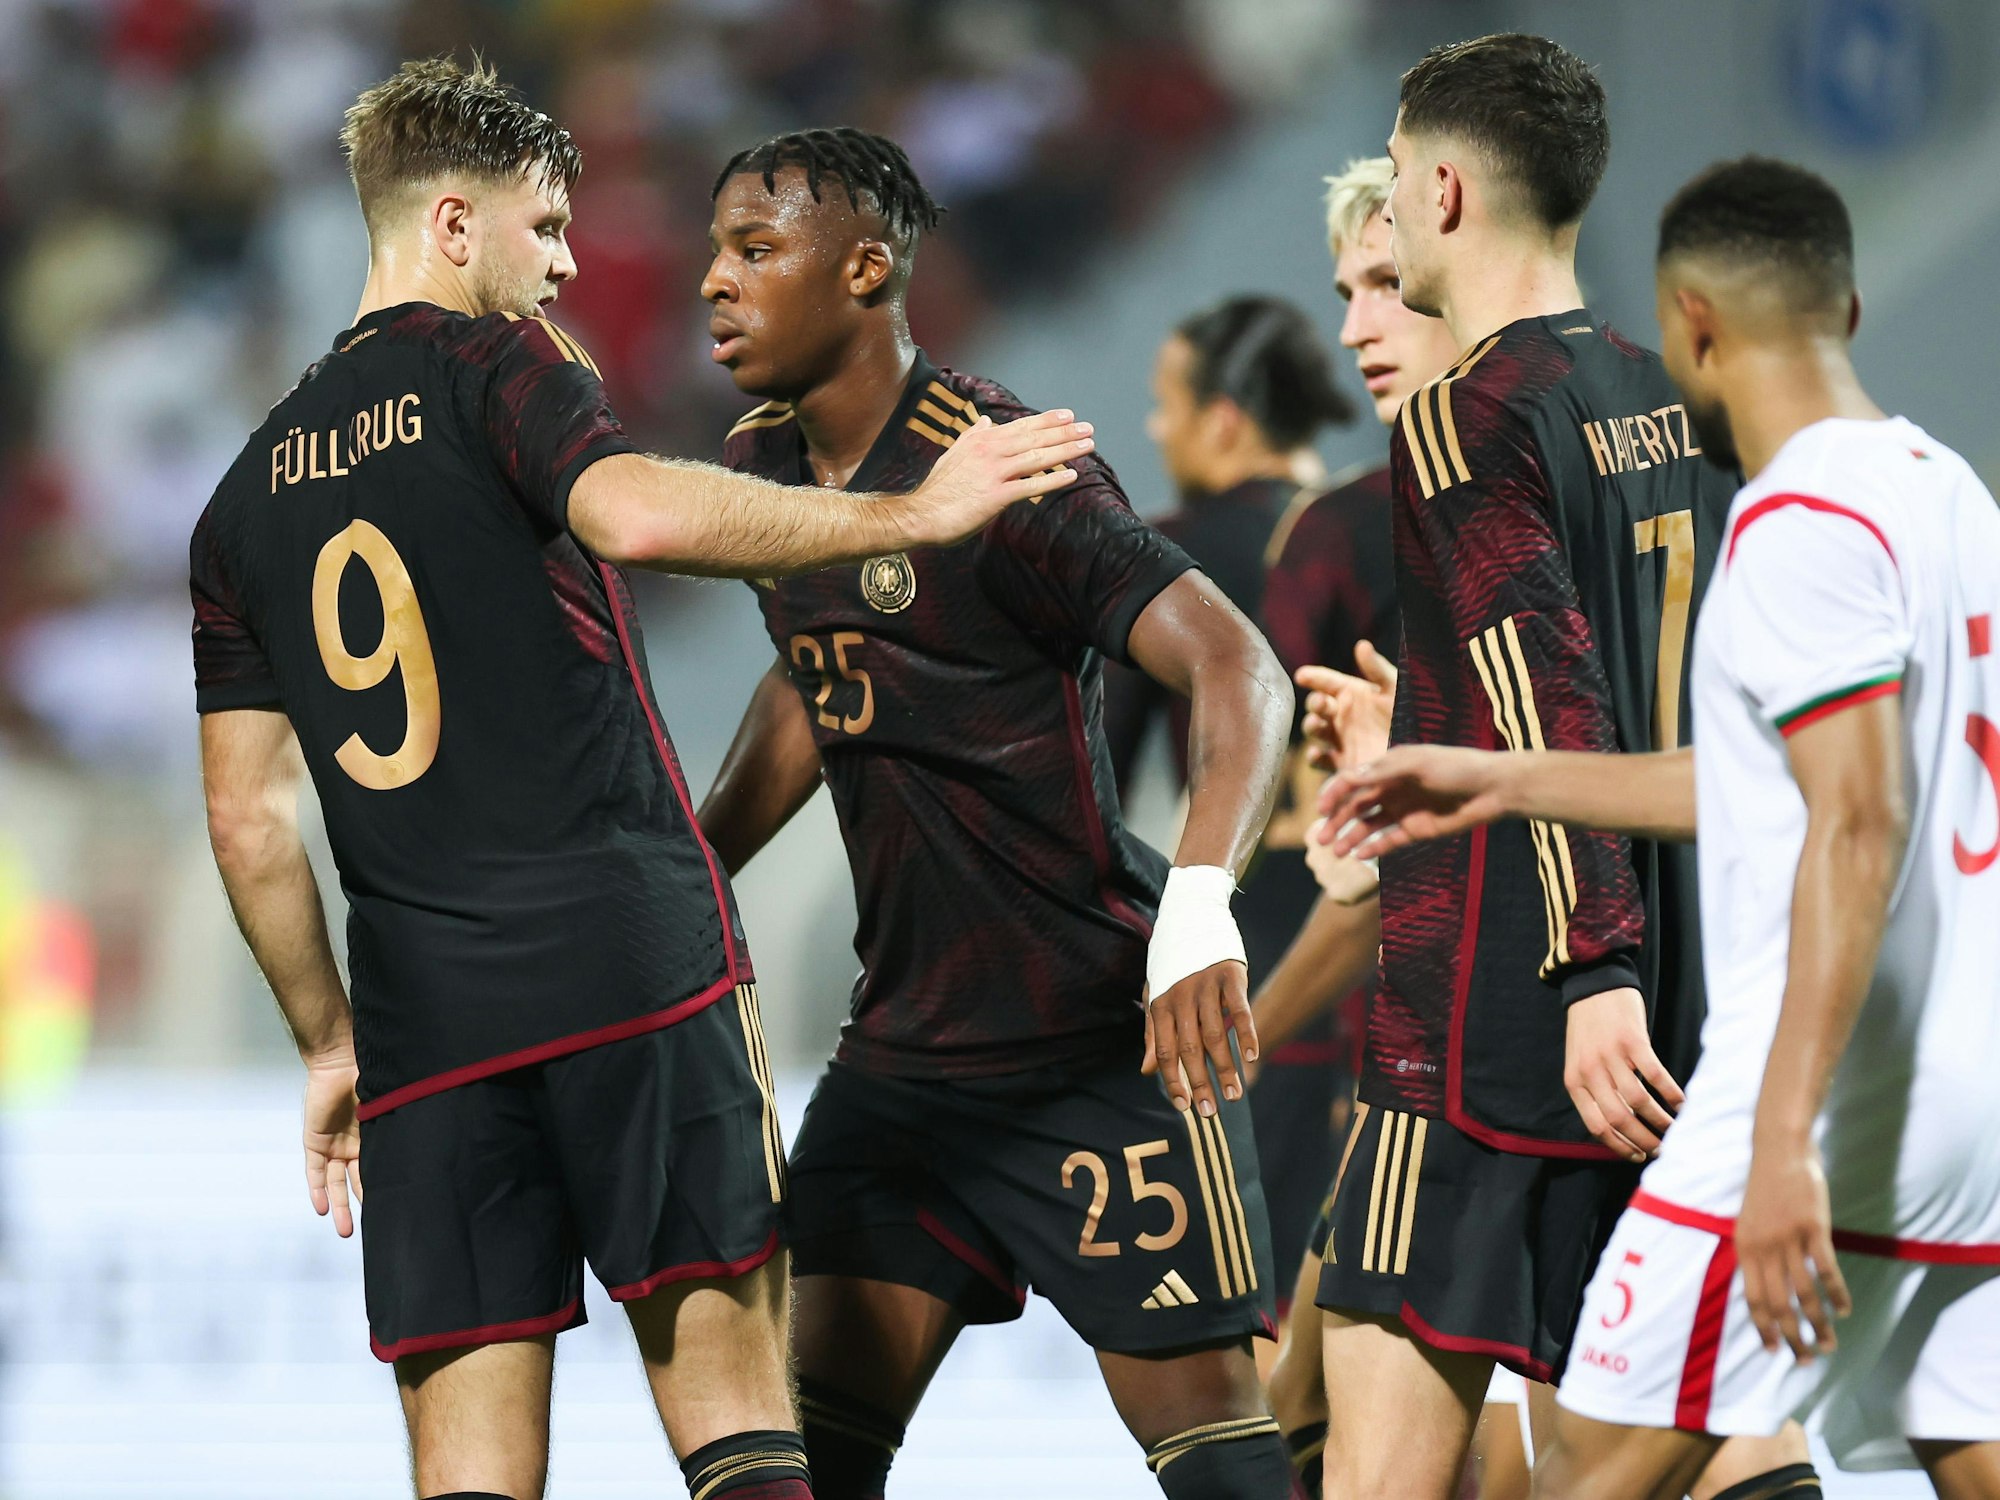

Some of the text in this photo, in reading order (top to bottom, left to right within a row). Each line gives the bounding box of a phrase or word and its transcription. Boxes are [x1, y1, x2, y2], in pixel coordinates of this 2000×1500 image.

[1583, 404, 1702, 476] HAVERTZ
[311, 518, 441, 790] 9
[790, 631, 875, 734] 25
[1634, 509, 1695, 750] 7
[1953, 613, 2000, 875] 5
[1061, 1139, 1189, 1257] 25
[1600, 1250, 1644, 1328] 5
